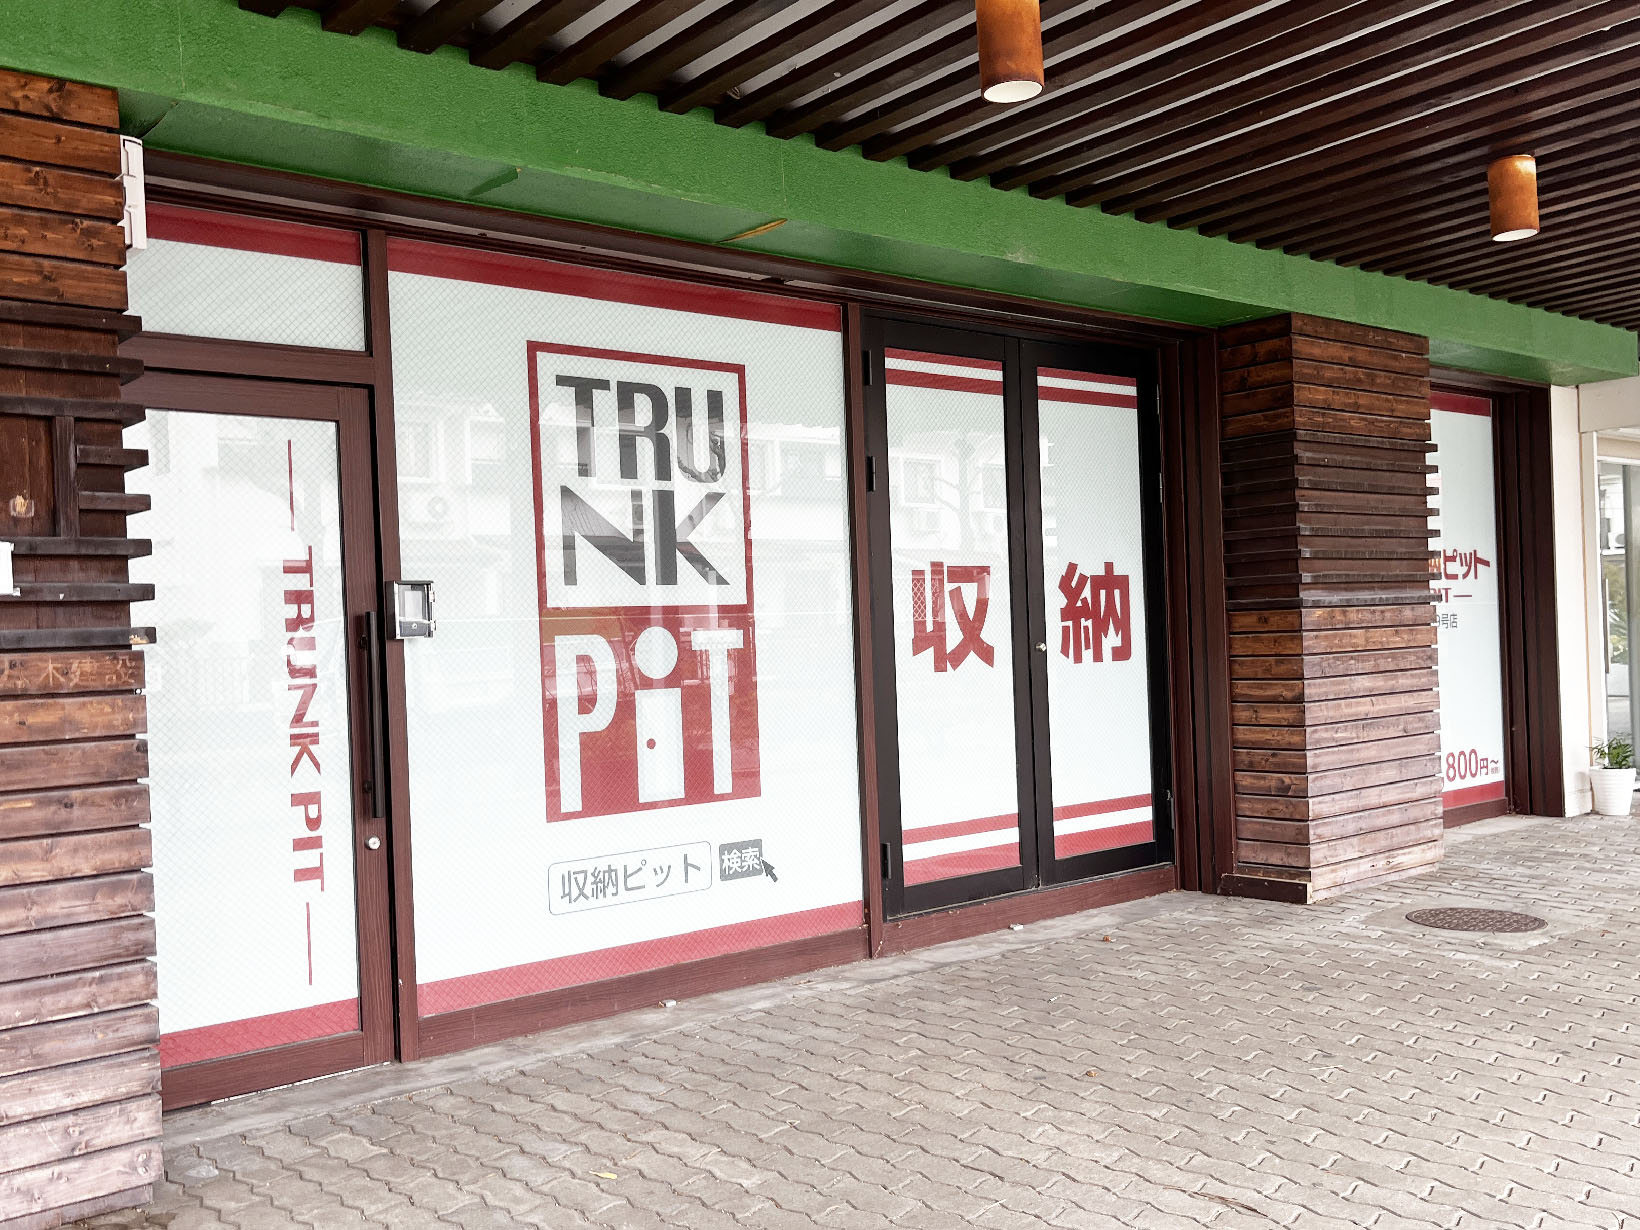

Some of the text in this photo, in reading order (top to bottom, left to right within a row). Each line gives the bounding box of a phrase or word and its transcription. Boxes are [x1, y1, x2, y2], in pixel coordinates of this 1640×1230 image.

[556, 375, 726, 483] TRU
[560, 485, 730, 585] NK
[1429, 549, 1490, 580] ピット
[282, 545, 325, 892] TRUNK PIT
[560, 846, 761, 904] 収納ピット 検索
